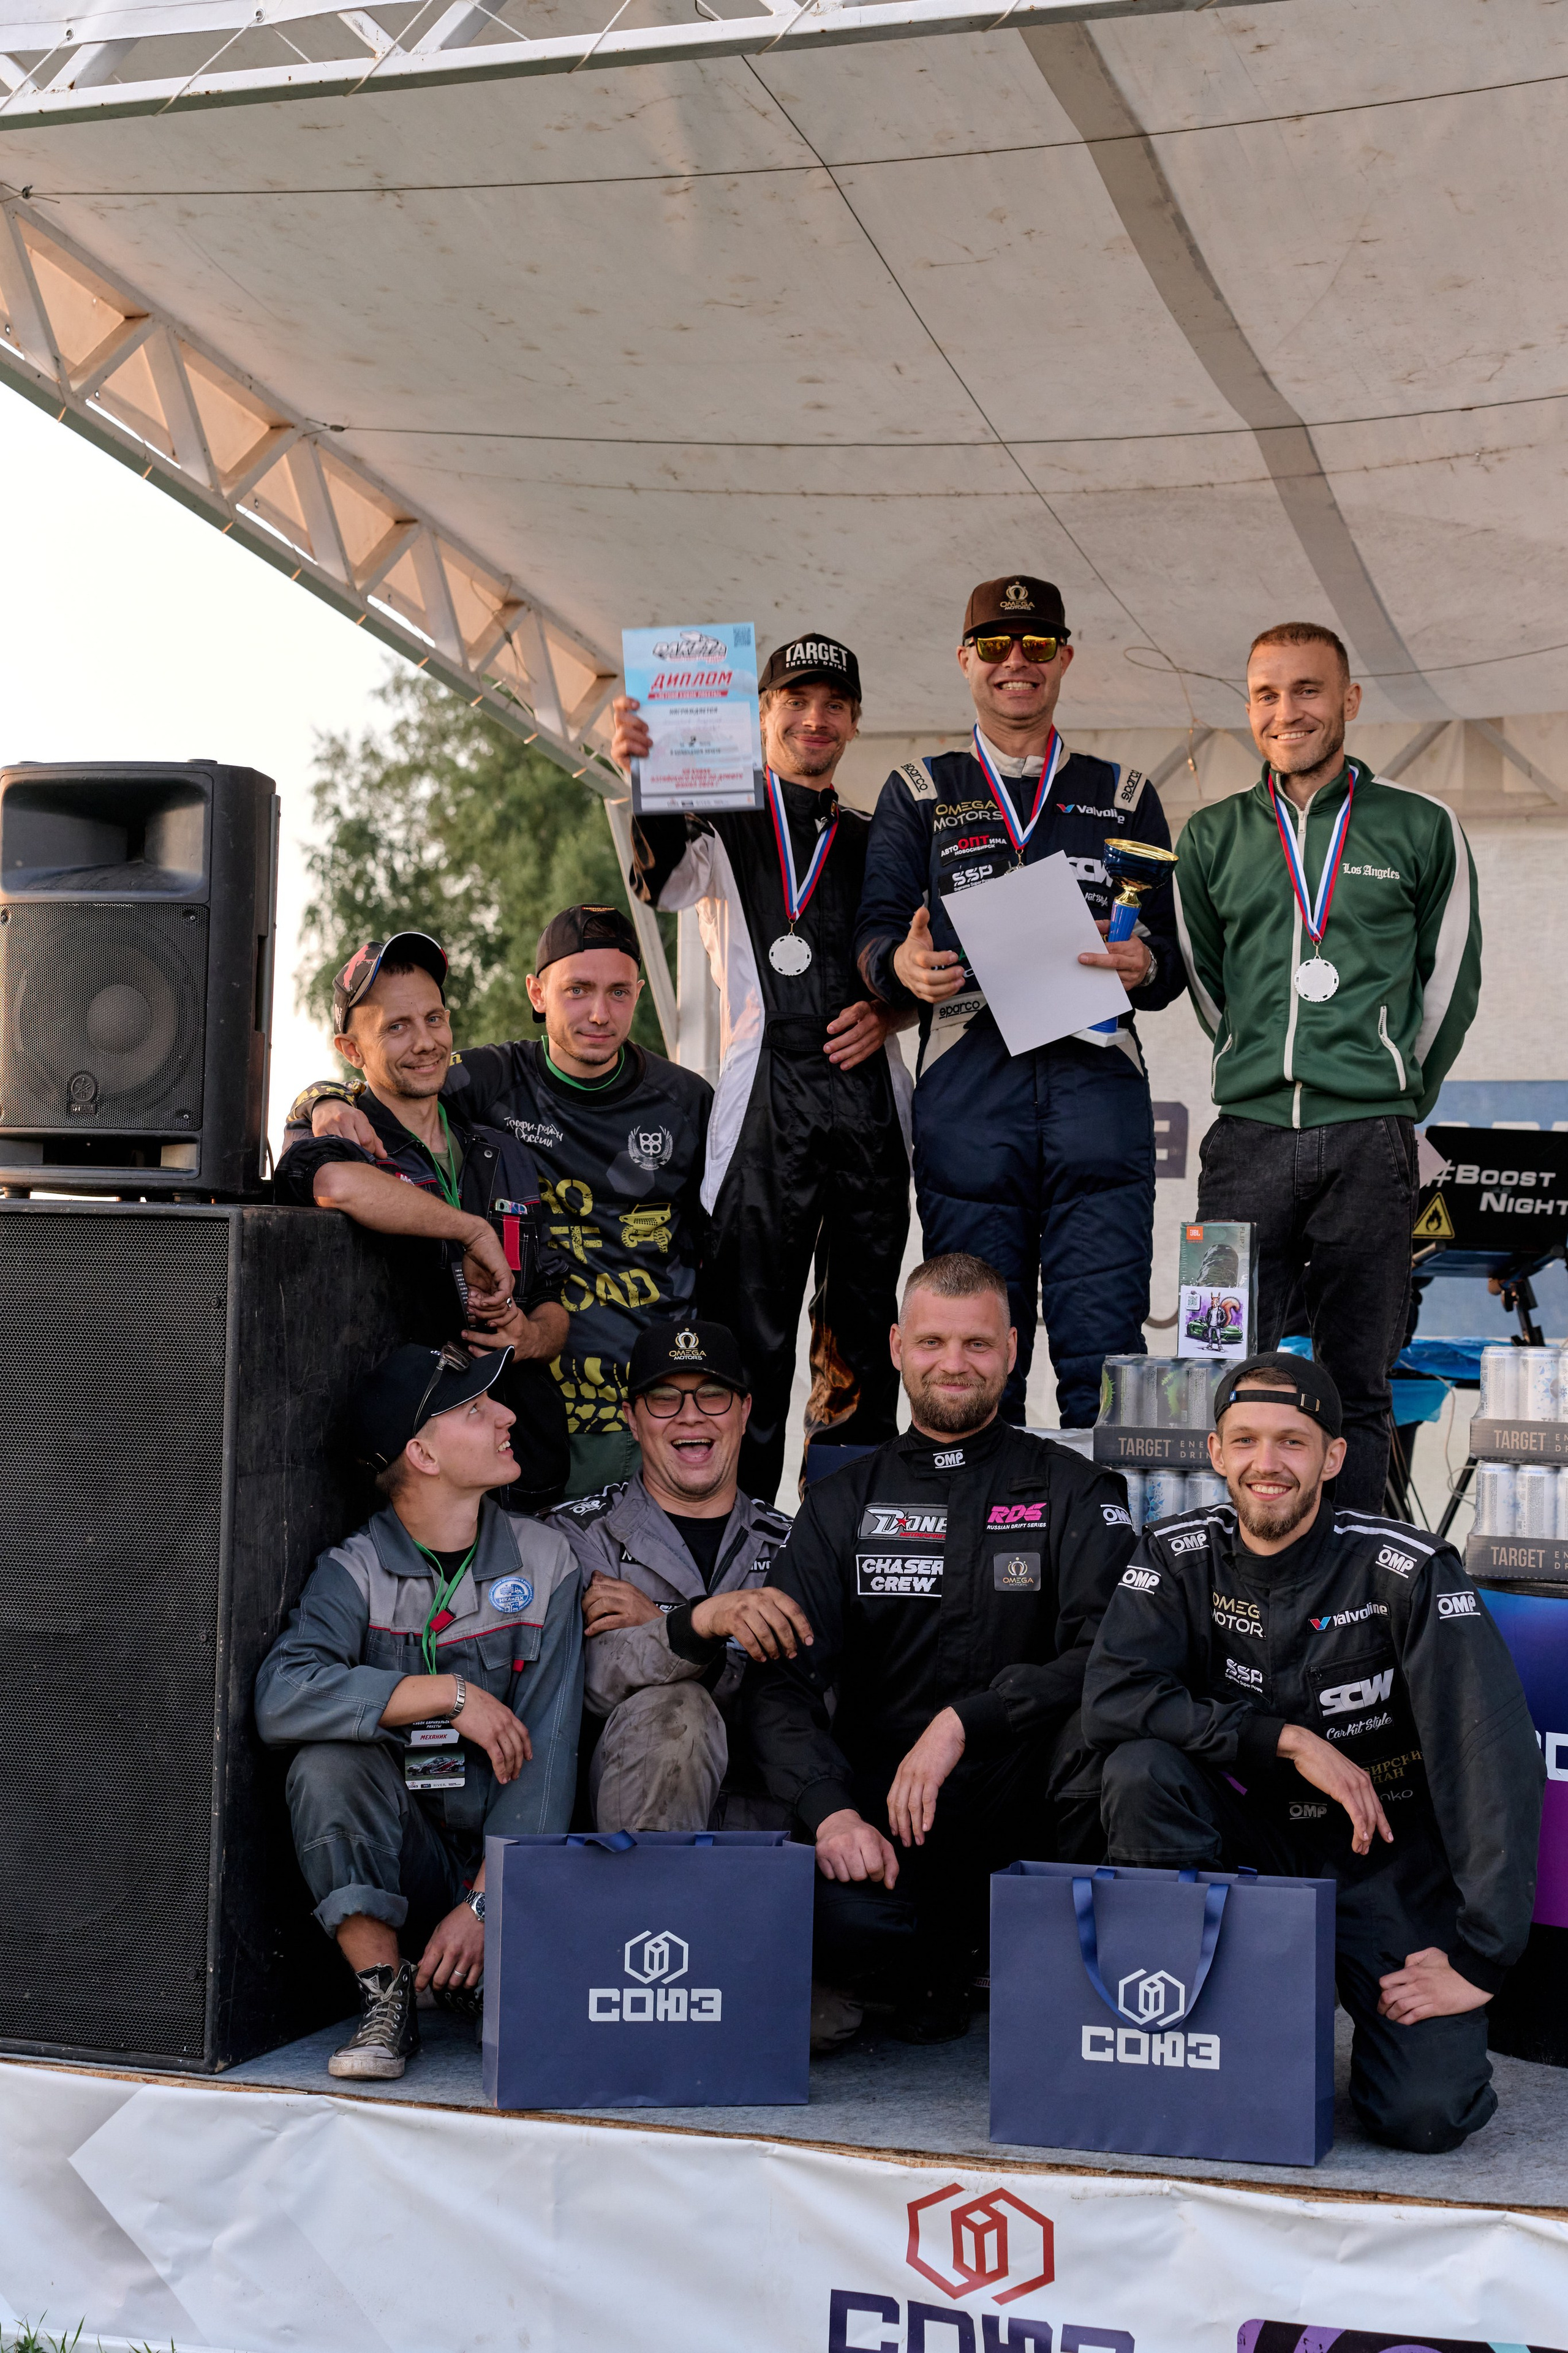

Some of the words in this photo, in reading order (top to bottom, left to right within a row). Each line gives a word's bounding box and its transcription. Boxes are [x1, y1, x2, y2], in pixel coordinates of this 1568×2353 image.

[785, 642, 848, 667] TARGET
[786, 660, 818, 668] ENERGY
[823, 660, 847, 672] DRINK
[651, 671, 733, 691] ДИПЛОМ
[935, 800, 998, 815] OMEGA
[1076, 804, 1125, 824] Valvolie
[933, 810, 1004, 832] MOTORS
[954, 844, 995, 856] НОВОСИБИРСК
[1343, 863, 1362, 874] Los
[1363, 864, 1400, 879] Angeles
[939, 1000, 980, 1019] sparco
[515, 1127, 552, 1147] России
[560, 1268, 660, 1312] OAD
[1118, 1438, 1171, 1457] TARGET
[1494, 1430, 1547, 1451] TARGET
[934, 1451, 963, 1467] OMP
[987, 1503, 1047, 1524] RDS
[1102, 1507, 1131, 1523] OM
[1170, 1533, 1207, 1552] OMP
[1378, 1548, 1414, 1573] OMP
[1491, 1546, 1545, 1568] TARGET
[870, 1576, 937, 1592] CREW
[1122, 1569, 1159, 1588] OMP
[1213, 1592, 1261, 1619] OMEG
[1333, 1602, 1388, 1626] Valvoline
[1438, 1595, 1476, 1615] OMP
[1210, 1608, 1264, 1638] MOTOR
[1319, 1668, 1394, 1716] SCW
[1289, 1805, 1327, 1818] OMP
[589, 1989, 722, 2022] СОЮЗ
[1082, 2025, 1220, 2070] СОЮЗ
